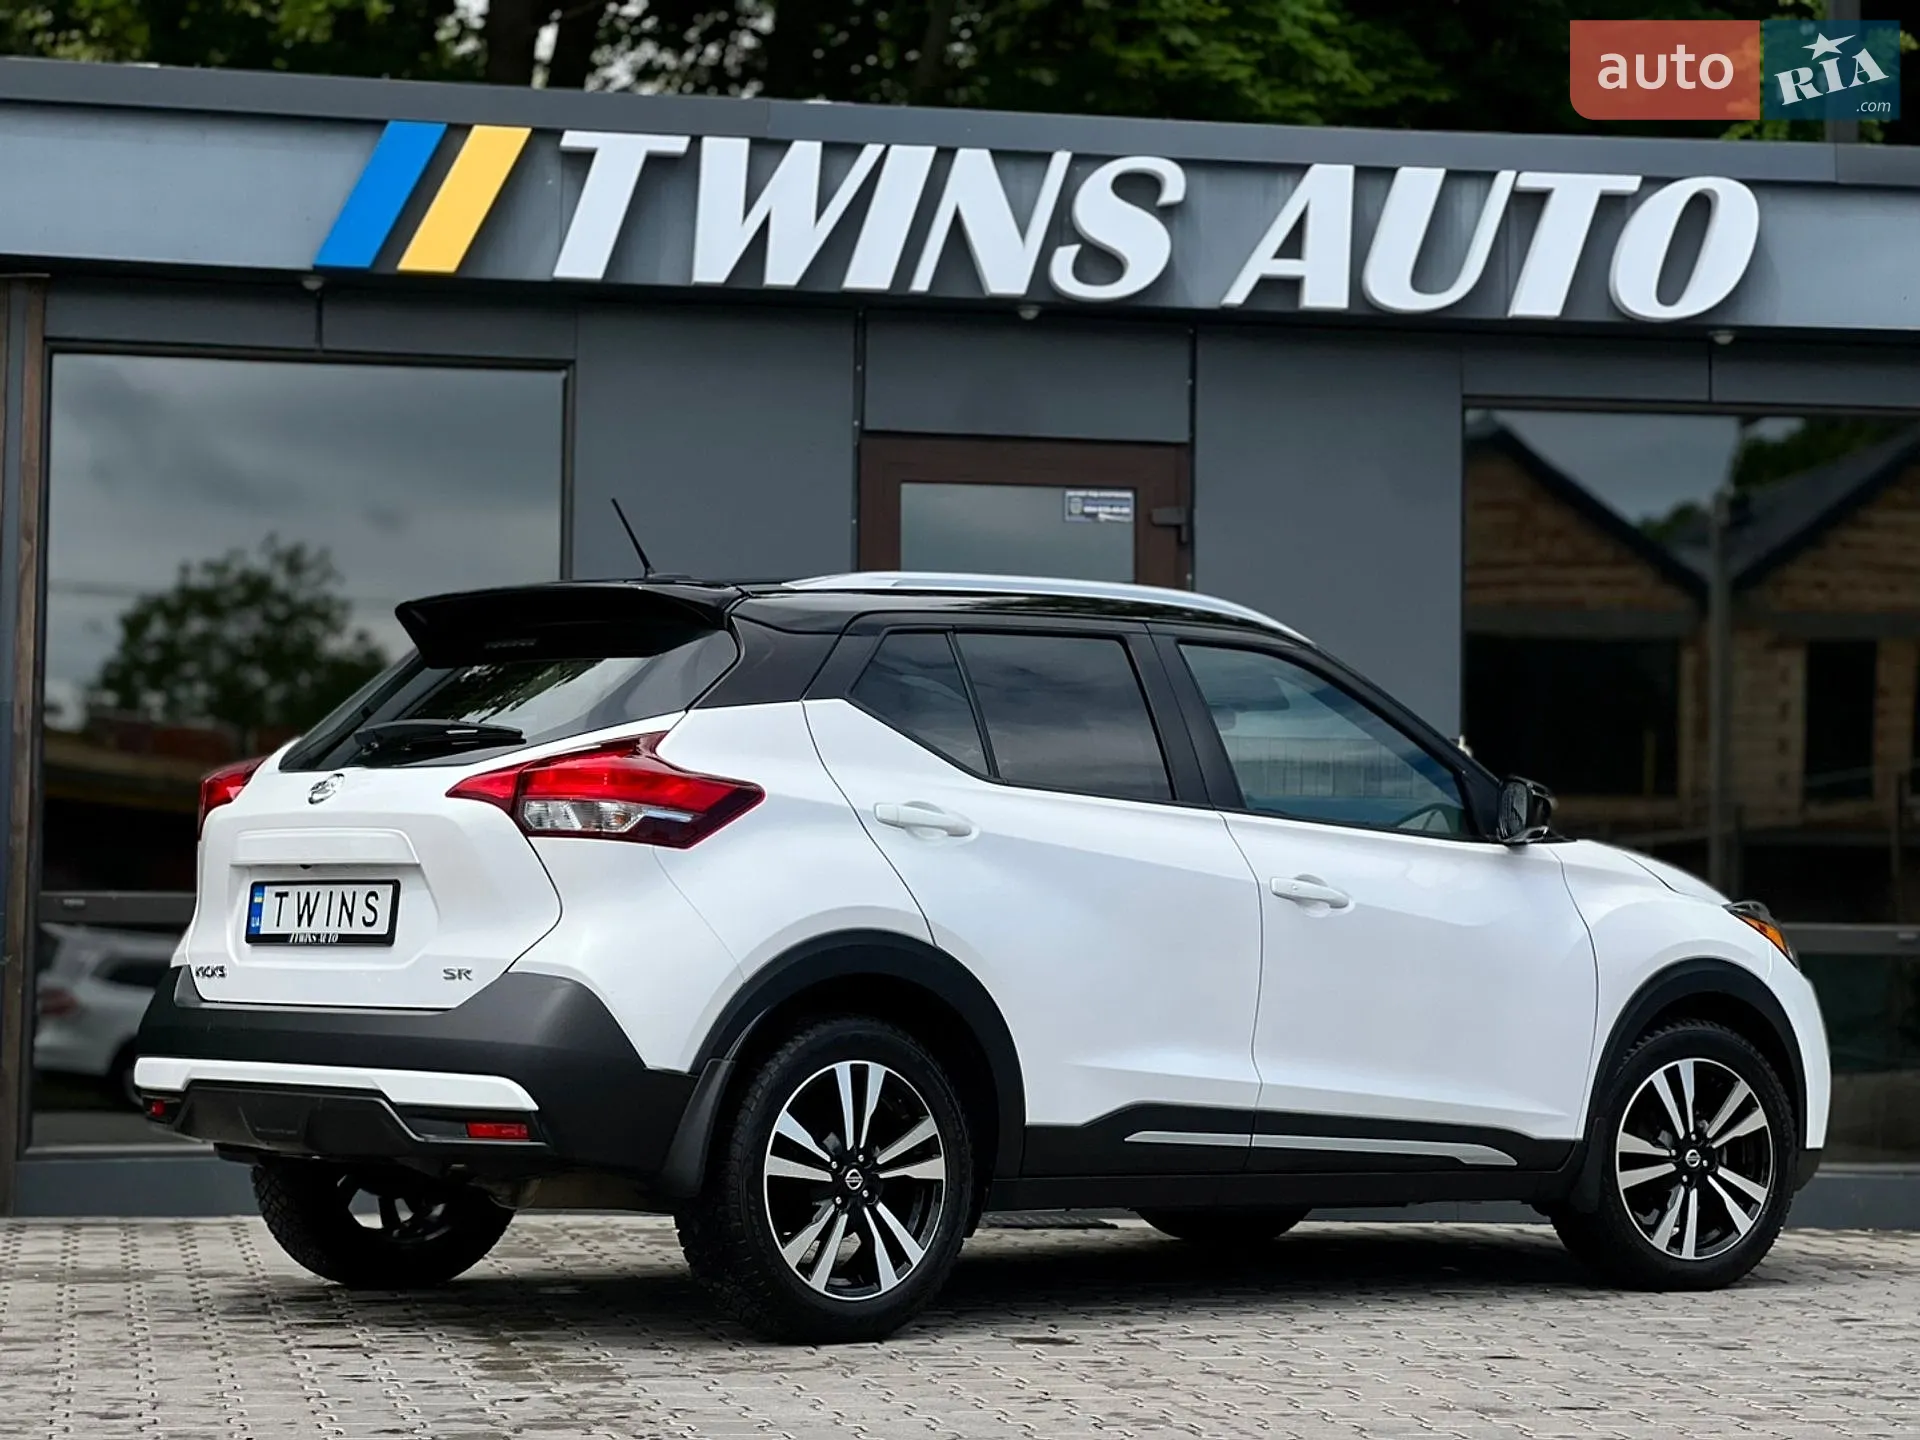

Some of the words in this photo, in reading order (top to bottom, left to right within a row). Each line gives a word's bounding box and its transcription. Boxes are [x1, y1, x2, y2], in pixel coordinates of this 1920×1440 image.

[552, 129, 1187, 302] TWINS
[1220, 162, 1760, 322] AUTO
[274, 890, 379, 928] TWINS
[442, 968, 473, 981] SR
